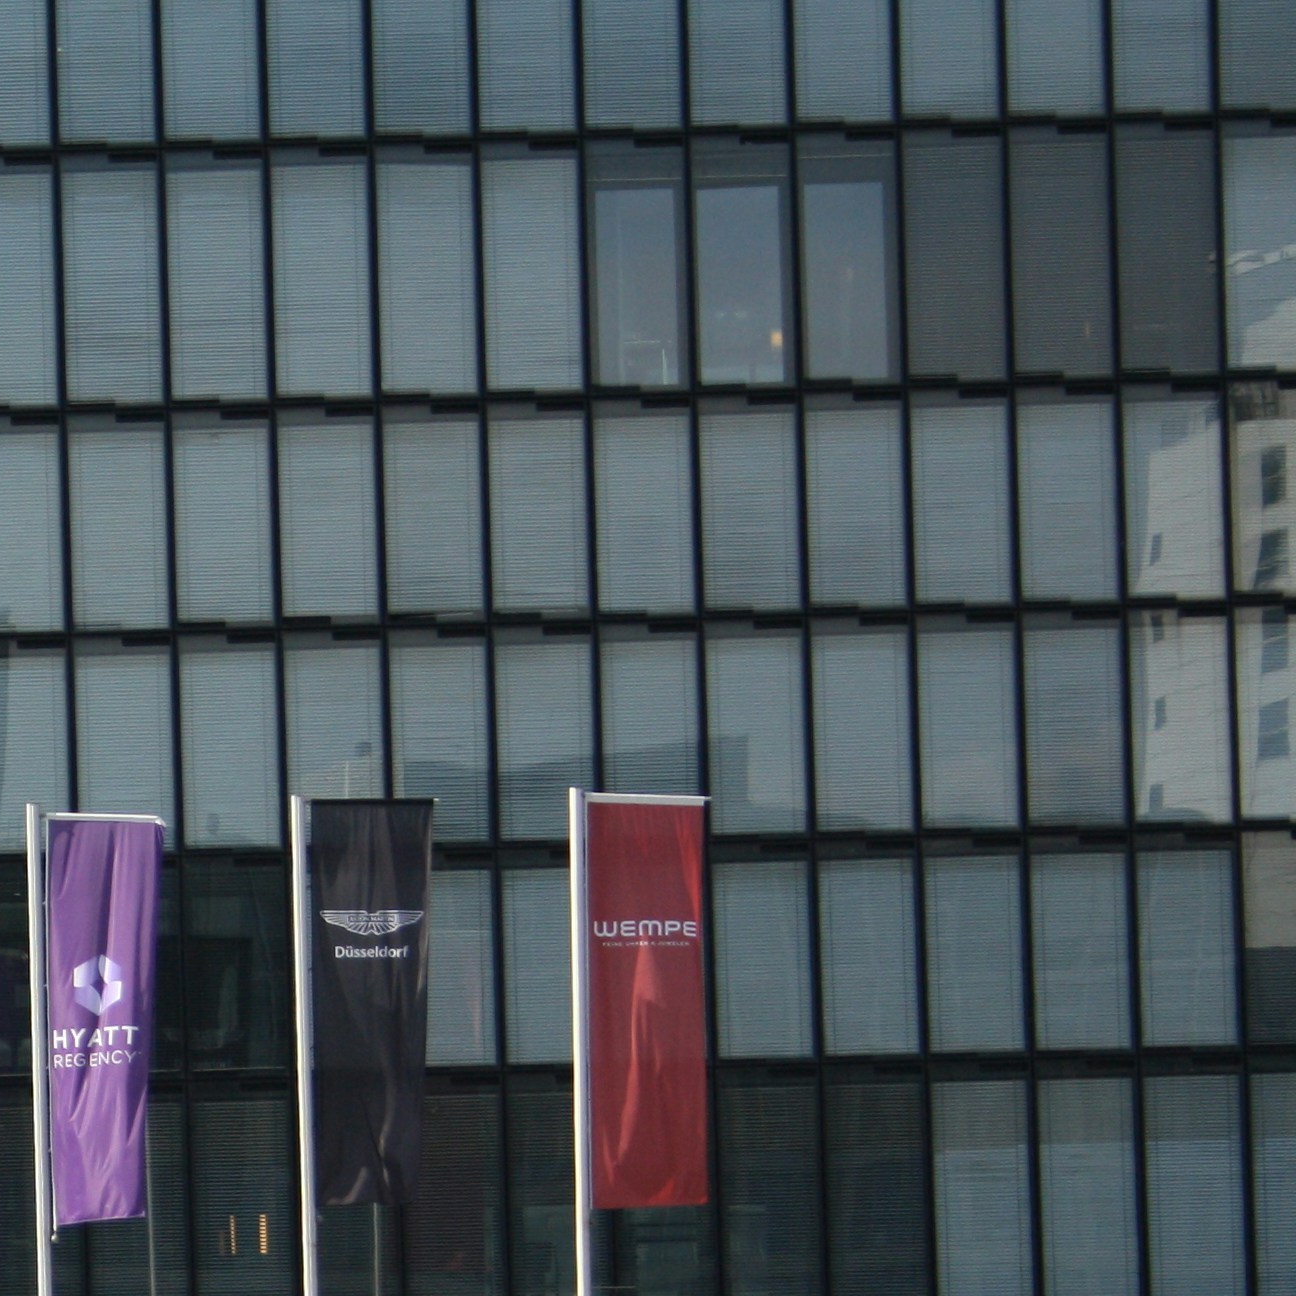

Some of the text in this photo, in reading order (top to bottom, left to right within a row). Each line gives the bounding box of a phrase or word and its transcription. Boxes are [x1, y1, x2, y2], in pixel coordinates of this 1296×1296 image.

[593, 920, 697, 938] WEMPE
[334, 945, 409, 958] Düsseldorf
[52, 1025, 139, 1050] HYATT
[53, 1050, 137, 1069] REGENCY
